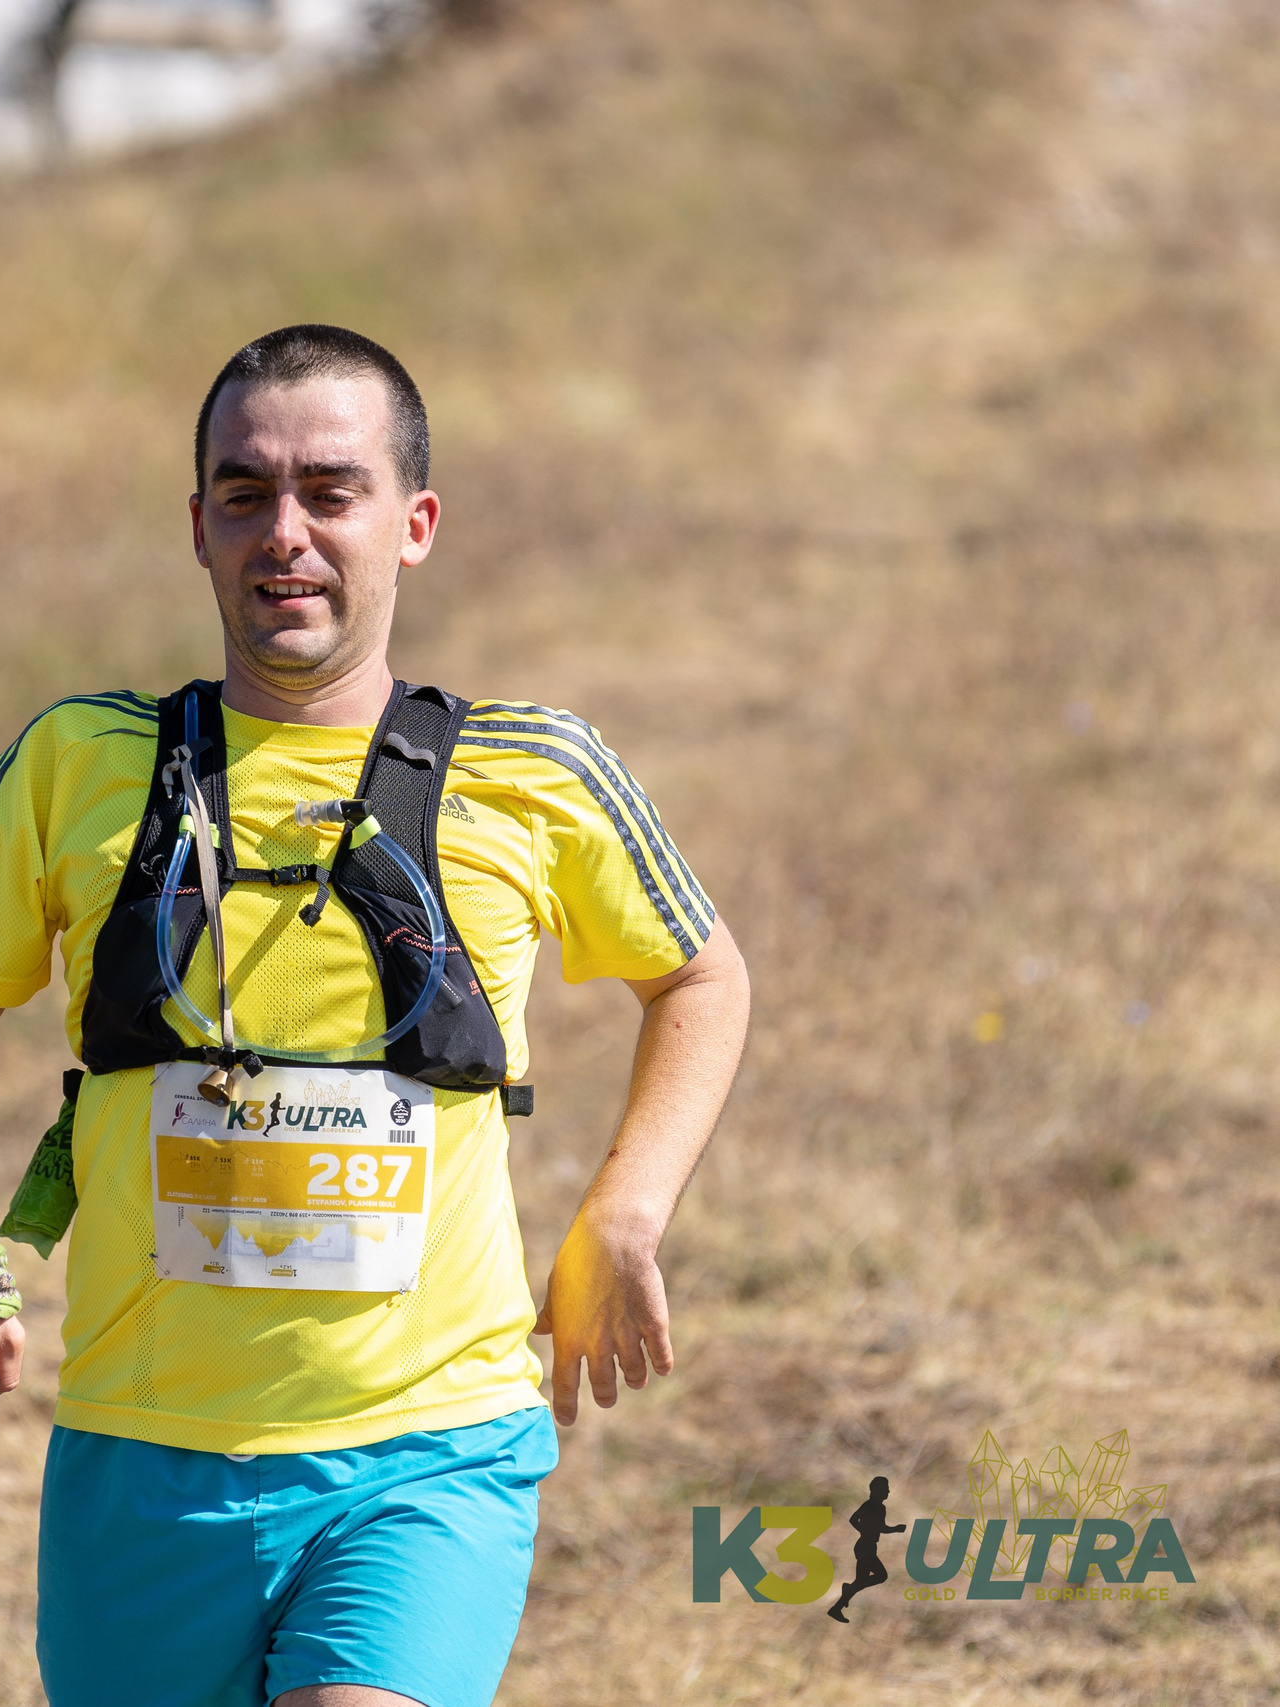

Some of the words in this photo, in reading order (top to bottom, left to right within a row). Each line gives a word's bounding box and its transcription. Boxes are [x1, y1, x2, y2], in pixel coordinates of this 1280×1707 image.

[438, 806, 476, 824] didas
[182, 1117, 217, 1127] САЛИНА
[227, 1100, 266, 1132] K3
[285, 1106, 368, 1132] ULTRA
[306, 1152, 413, 1198] 287
[306, 1199, 348, 1208] STEFANOV,
